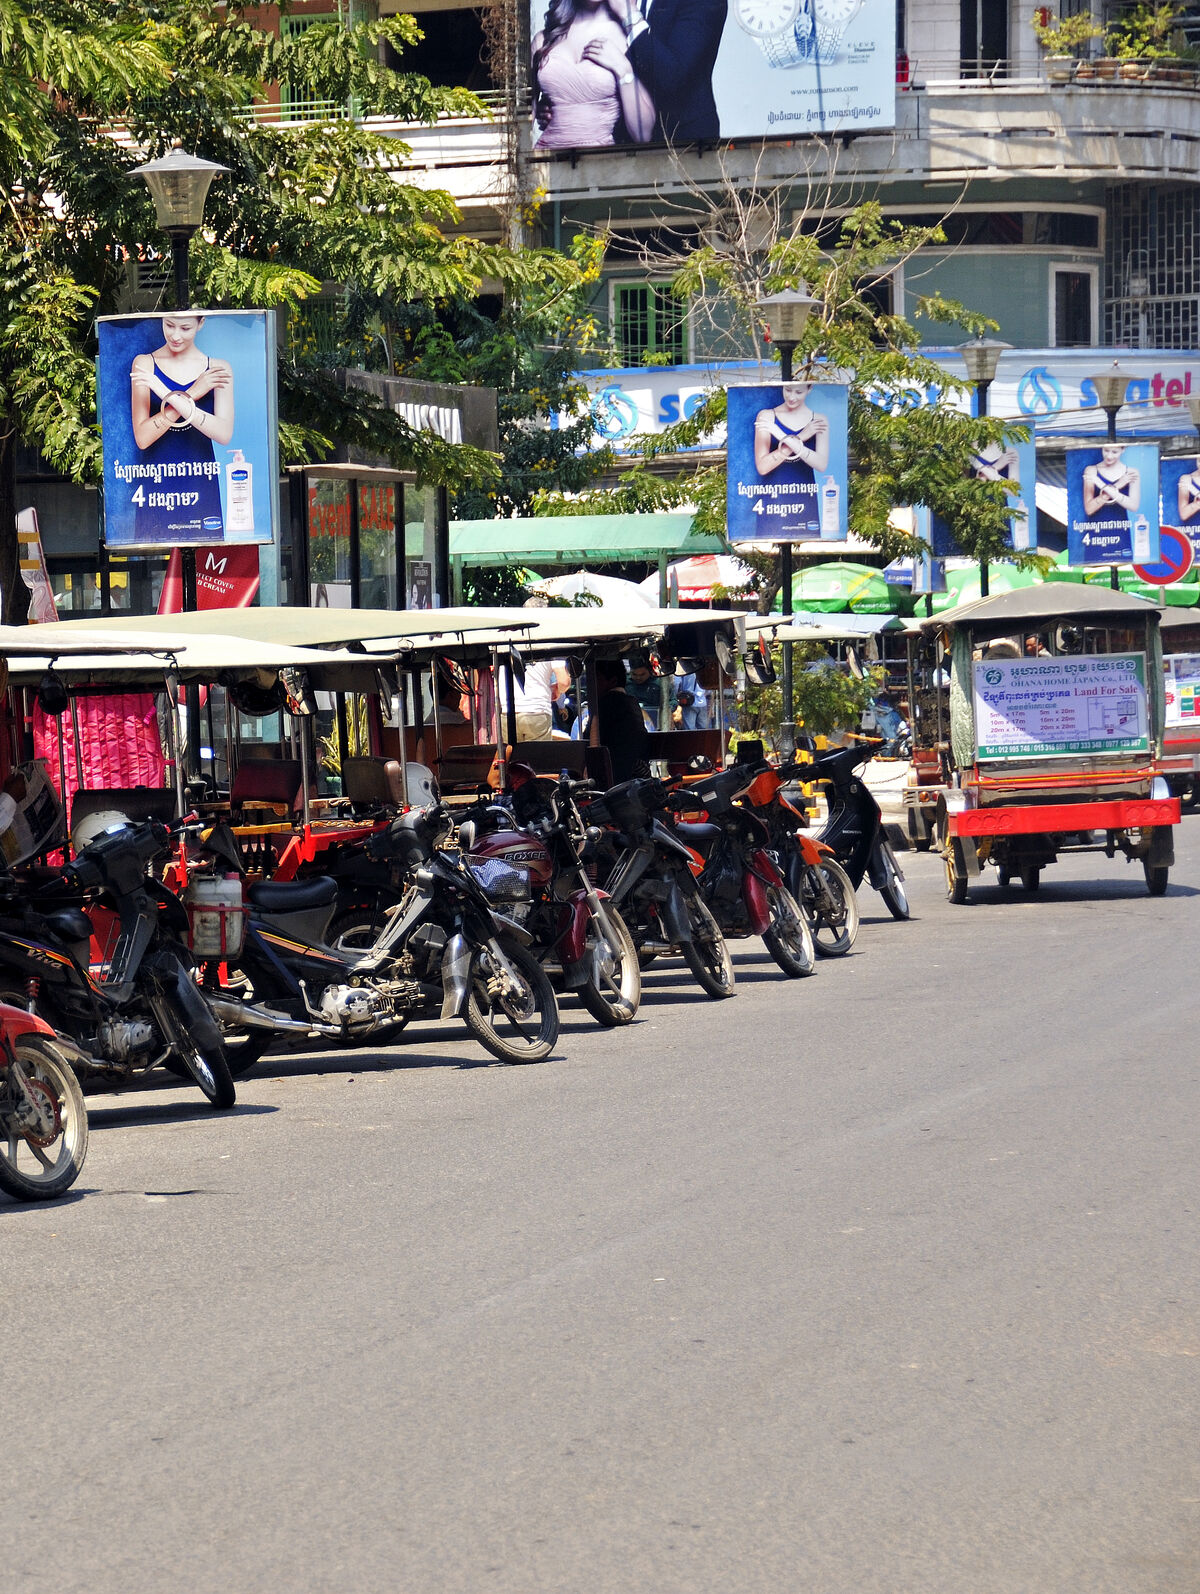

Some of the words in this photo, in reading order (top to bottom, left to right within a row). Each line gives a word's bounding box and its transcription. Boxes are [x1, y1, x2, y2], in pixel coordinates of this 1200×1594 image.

[1079, 371, 1192, 409] satel
[131, 484, 146, 508] 4
[308, 487, 351, 537] Event
[359, 485, 395, 532] SALE
[752, 498, 765, 515] 4
[1081, 532, 1091, 546] 4
[204, 551, 228, 575] M
[203, 581, 226, 594] CREAM
[213, 578, 235, 590] COVER
[1044, 677, 1070, 686] HOME
[1072, 676, 1100, 684] JAPAN
[1119, 673, 1137, 681] LTD
[1074, 686, 1098, 697] Land
[1101, 685, 1117, 695] For
[1119, 684, 1138, 694] Sale
[26, 948, 63, 970] Viva
